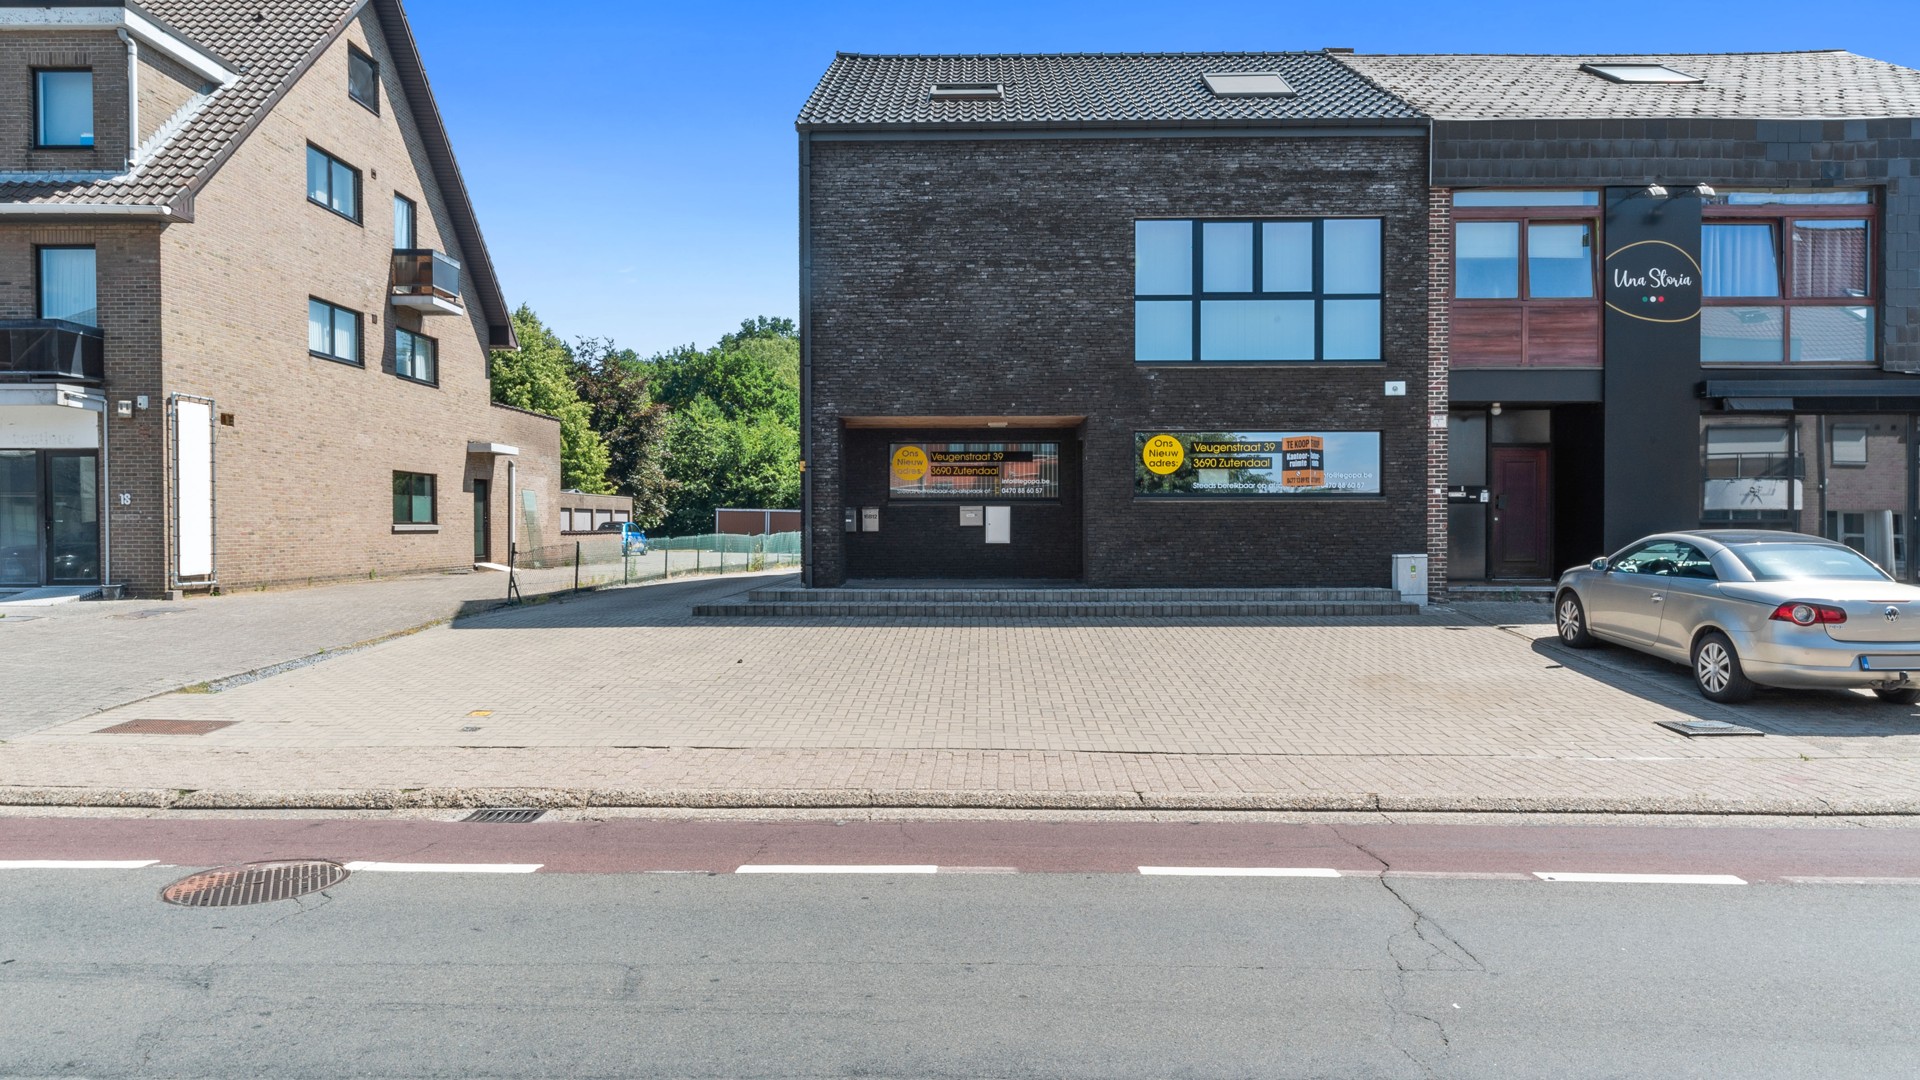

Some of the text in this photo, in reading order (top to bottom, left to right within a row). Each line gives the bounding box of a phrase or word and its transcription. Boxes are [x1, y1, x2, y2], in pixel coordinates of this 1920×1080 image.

[1614, 267, 1692, 289] Una Storia
[1154, 439, 1174, 448] Ons
[1193, 442, 1276, 454] Veugenstraat 39
[1286, 440, 1294, 449] TE
[1295, 439, 1310, 448] KOOP
[901, 449, 919, 457] Ons
[931, 452, 1004, 462] Veugenstraat 39
[1148, 449, 1179, 458] Nieuw
[896, 458, 924, 466] Nieuw
[1148, 458, 1179, 468] adres:
[1193, 458, 1270, 468] 3690 Zutendaal
[931, 466, 999, 475] 3690 Zutendaal
[1001, 487, 1017, 495] 0470
[1026, 487, 1035, 495] 60
[1035, 487, 1043, 495] 57
[1192, 481, 1216, 489] Steeds
[1217, 481, 1256, 489] bereikbaar
[1256, 483, 1267, 491] op
[119, 493, 131, 505] 18
